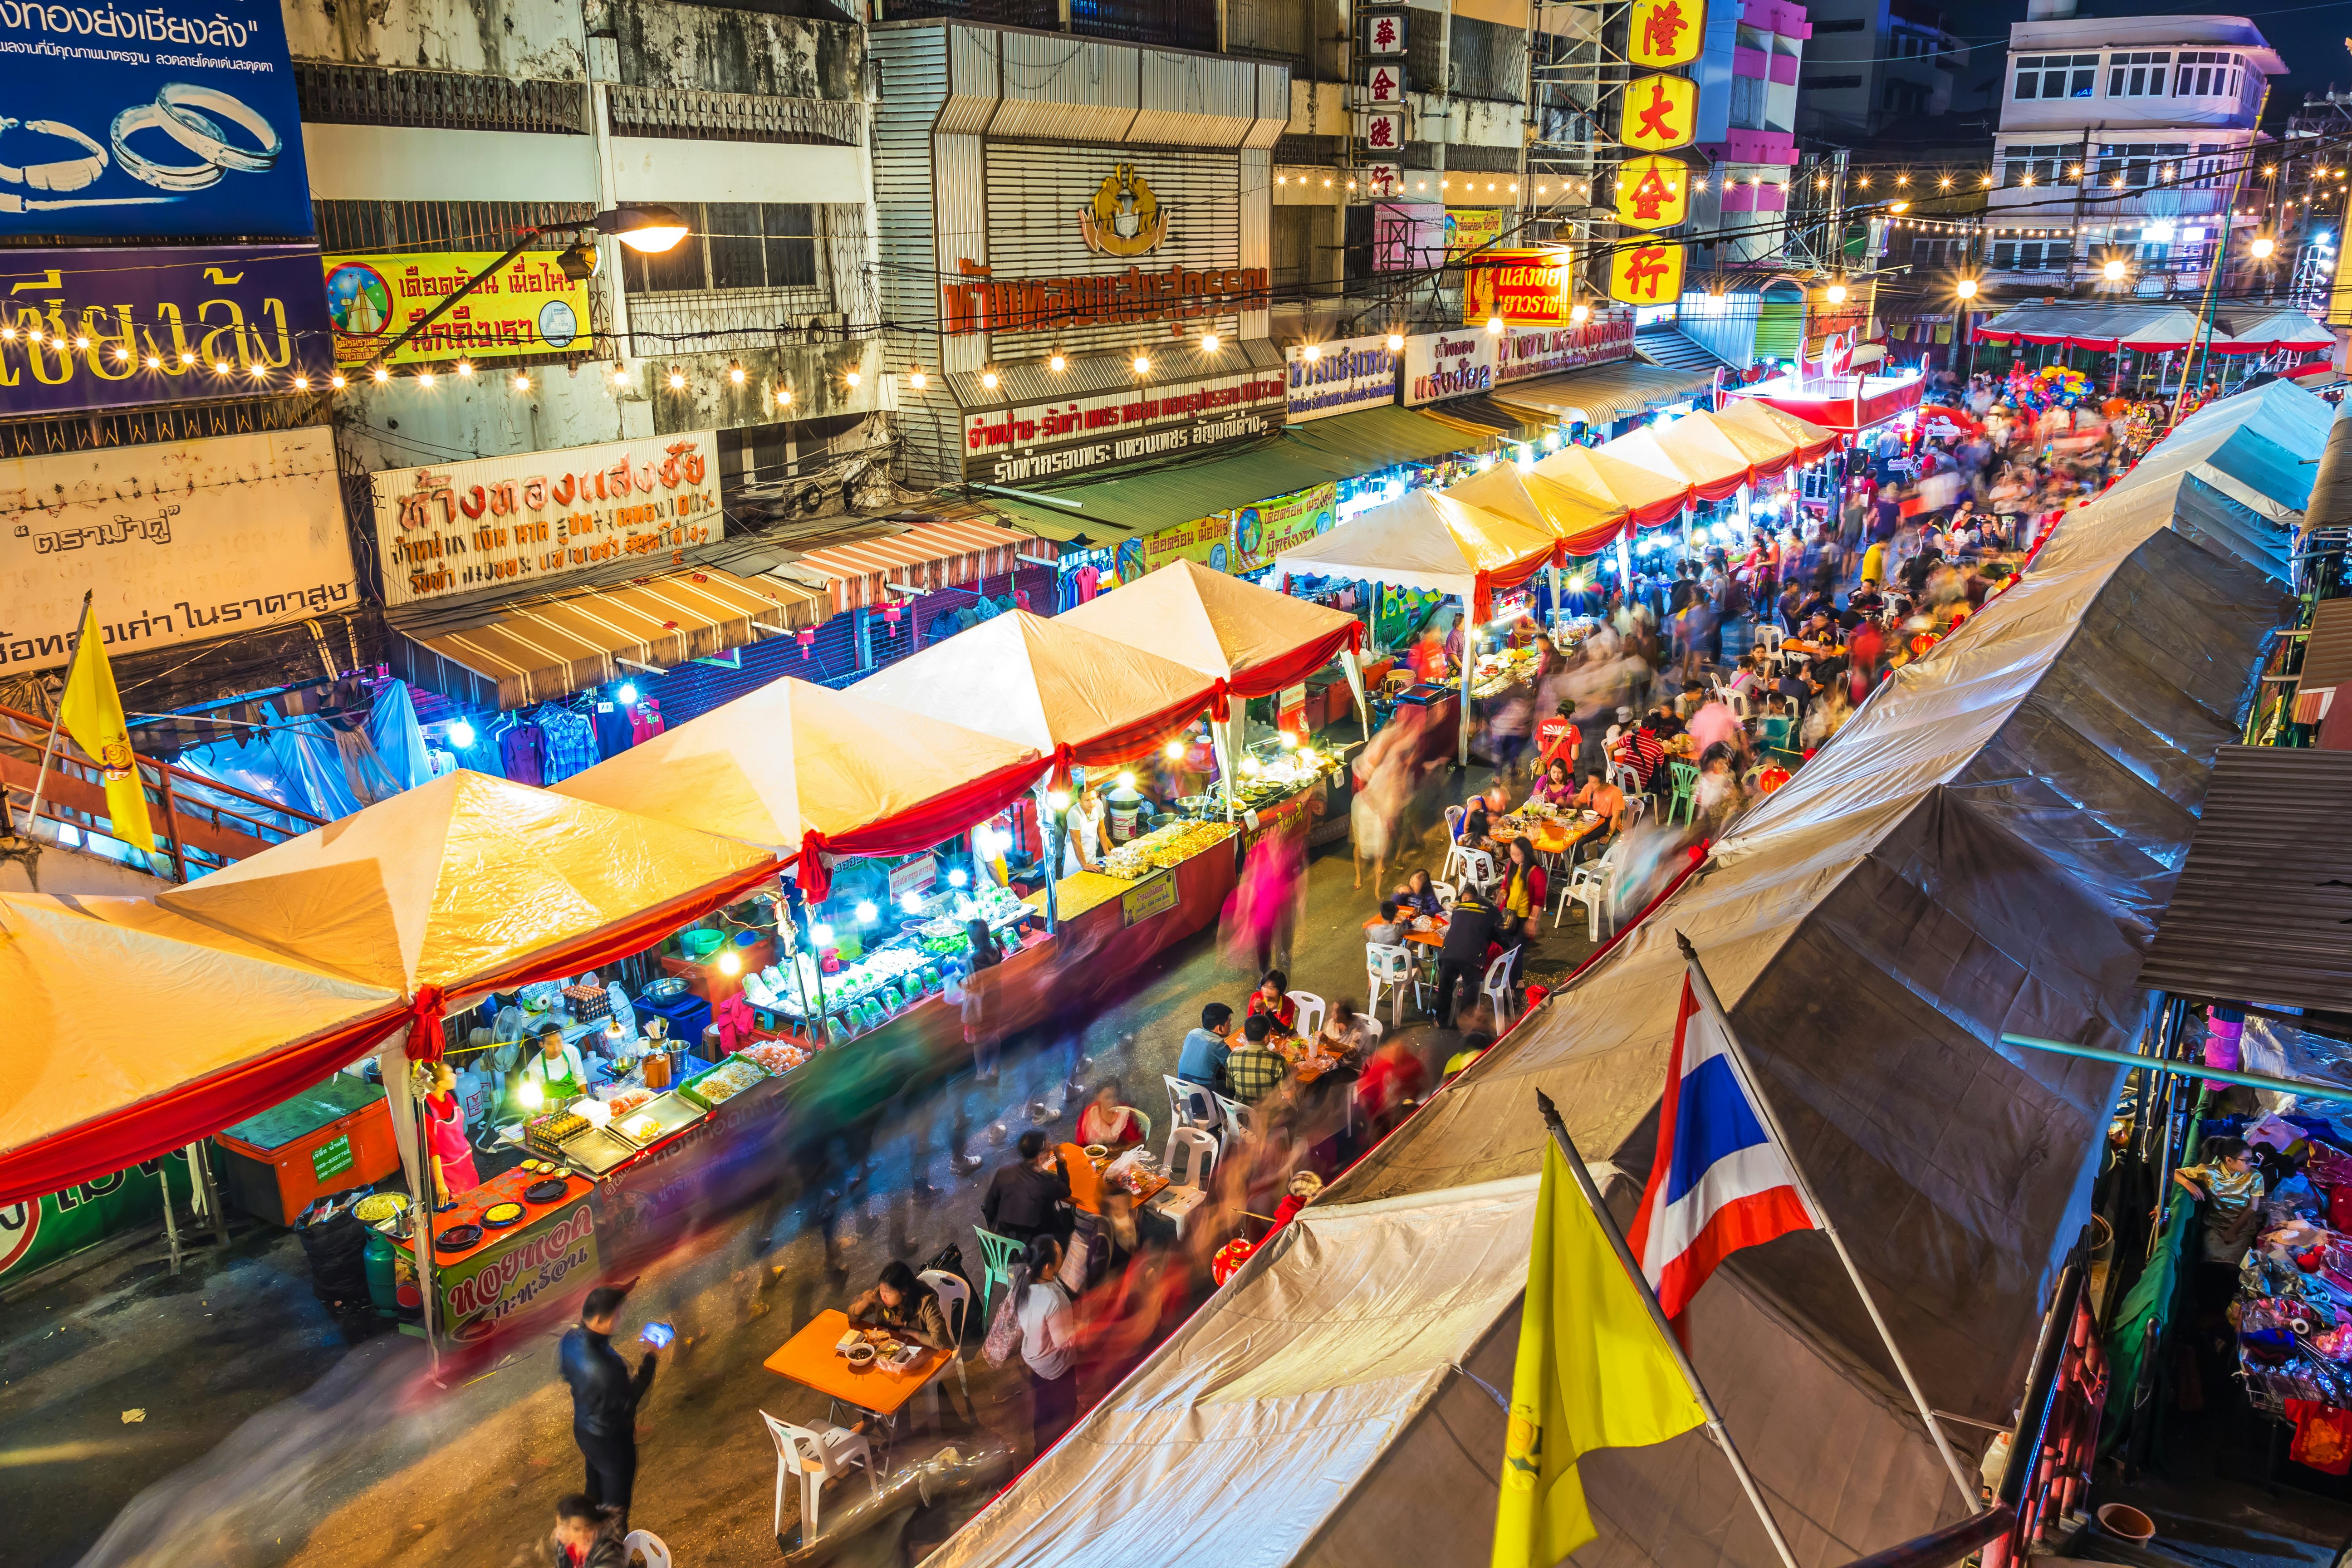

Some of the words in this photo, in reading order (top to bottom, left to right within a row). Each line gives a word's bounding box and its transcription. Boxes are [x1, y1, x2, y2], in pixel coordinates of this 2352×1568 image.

[156, 53, 273, 74] ลวดลายโดดเด่นสะดุดตา
